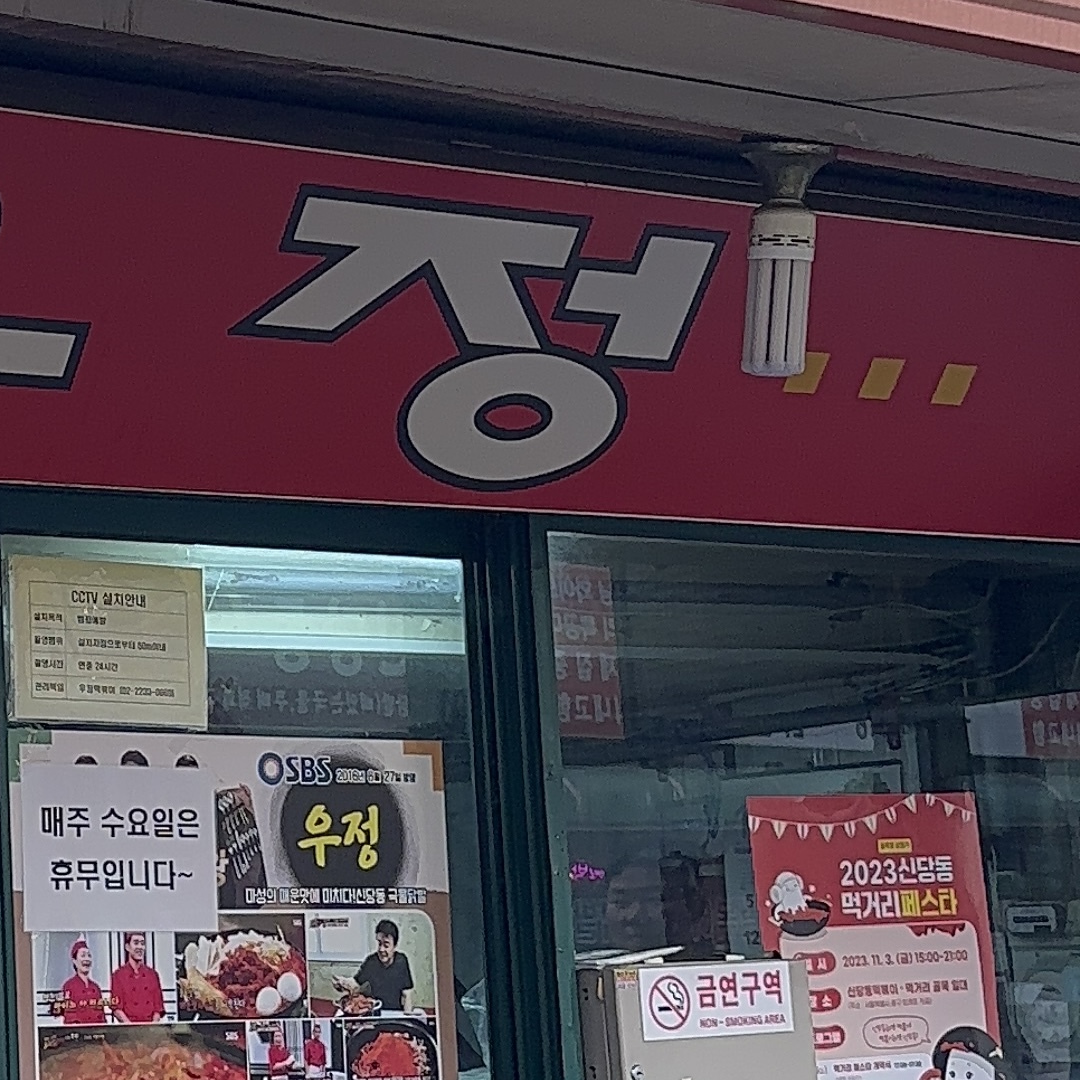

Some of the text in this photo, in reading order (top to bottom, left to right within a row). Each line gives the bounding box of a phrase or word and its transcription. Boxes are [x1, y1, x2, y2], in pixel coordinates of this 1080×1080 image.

[72, 590, 146, 609] CCTV 설치안내
[286, 756, 331, 785] SBS
[41, 805, 200, 839] 매주 수요일은
[298, 804, 379, 870] 우정
[50, 858, 193, 891] 휴무입니다~
[839, 855, 955, 887] 2023신당동
[841, 888, 958, 919] 먹거리페스타
[696, 969, 783, 1009] 금연구역
[764, 1013, 786, 1025] AREA
